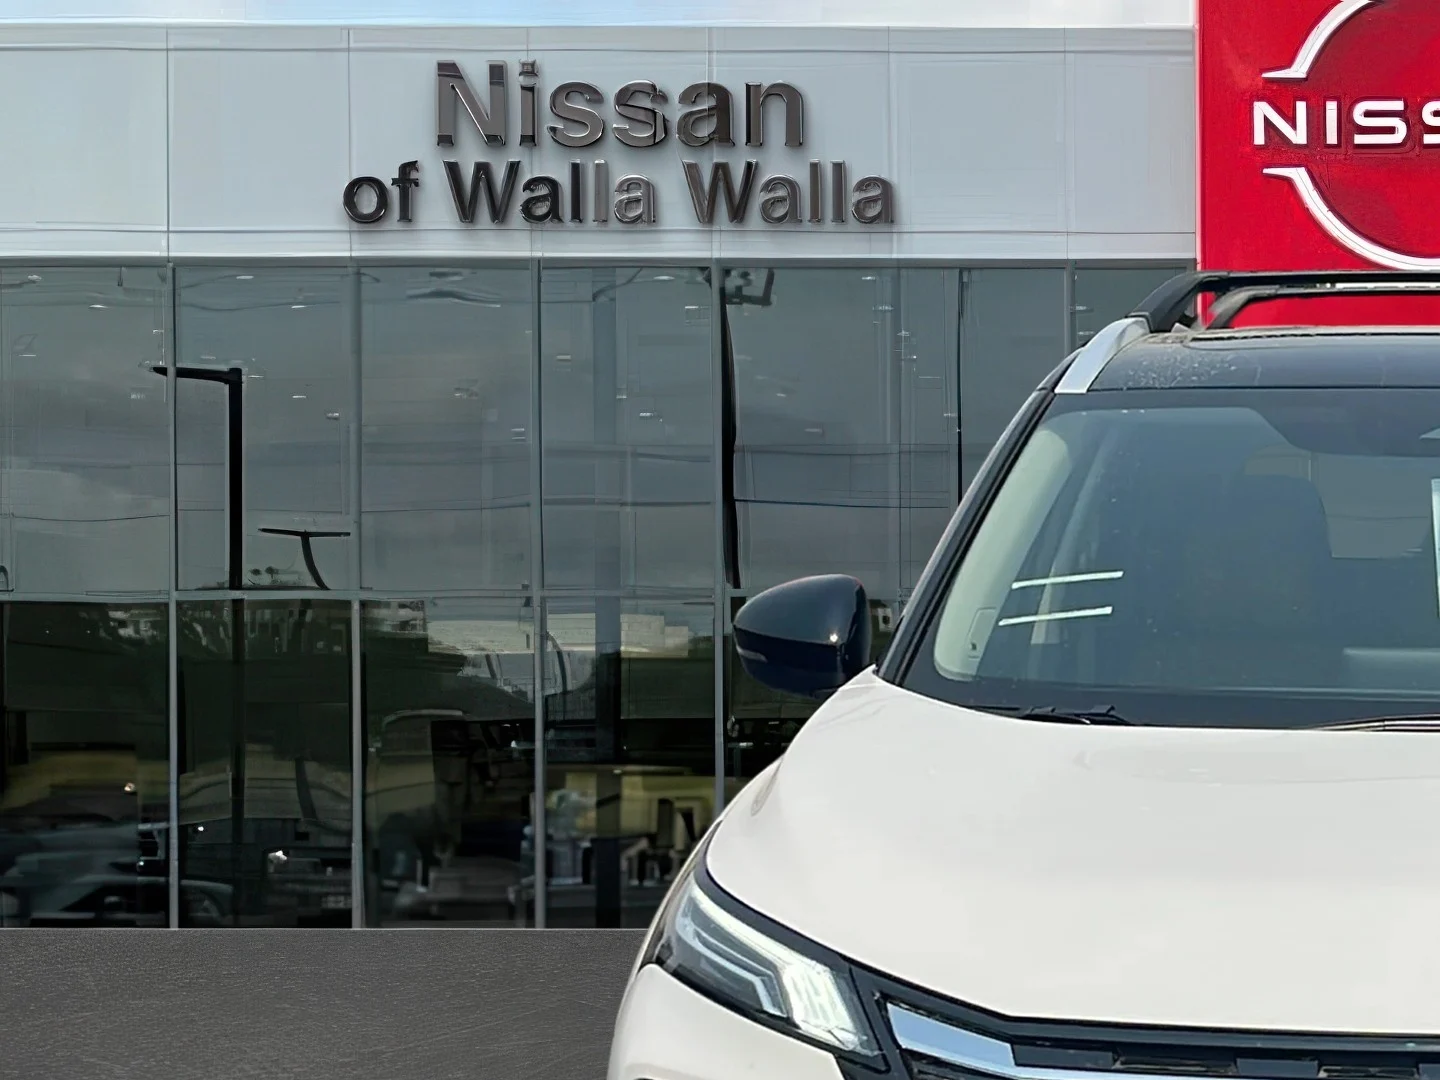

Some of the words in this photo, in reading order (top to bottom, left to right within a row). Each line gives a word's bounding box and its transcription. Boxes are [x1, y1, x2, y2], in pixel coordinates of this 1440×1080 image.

[435, 58, 805, 148] Nissan
[342, 160, 420, 224] of
[442, 160, 658, 224] Walla
[681, 160, 895, 224] Walla
